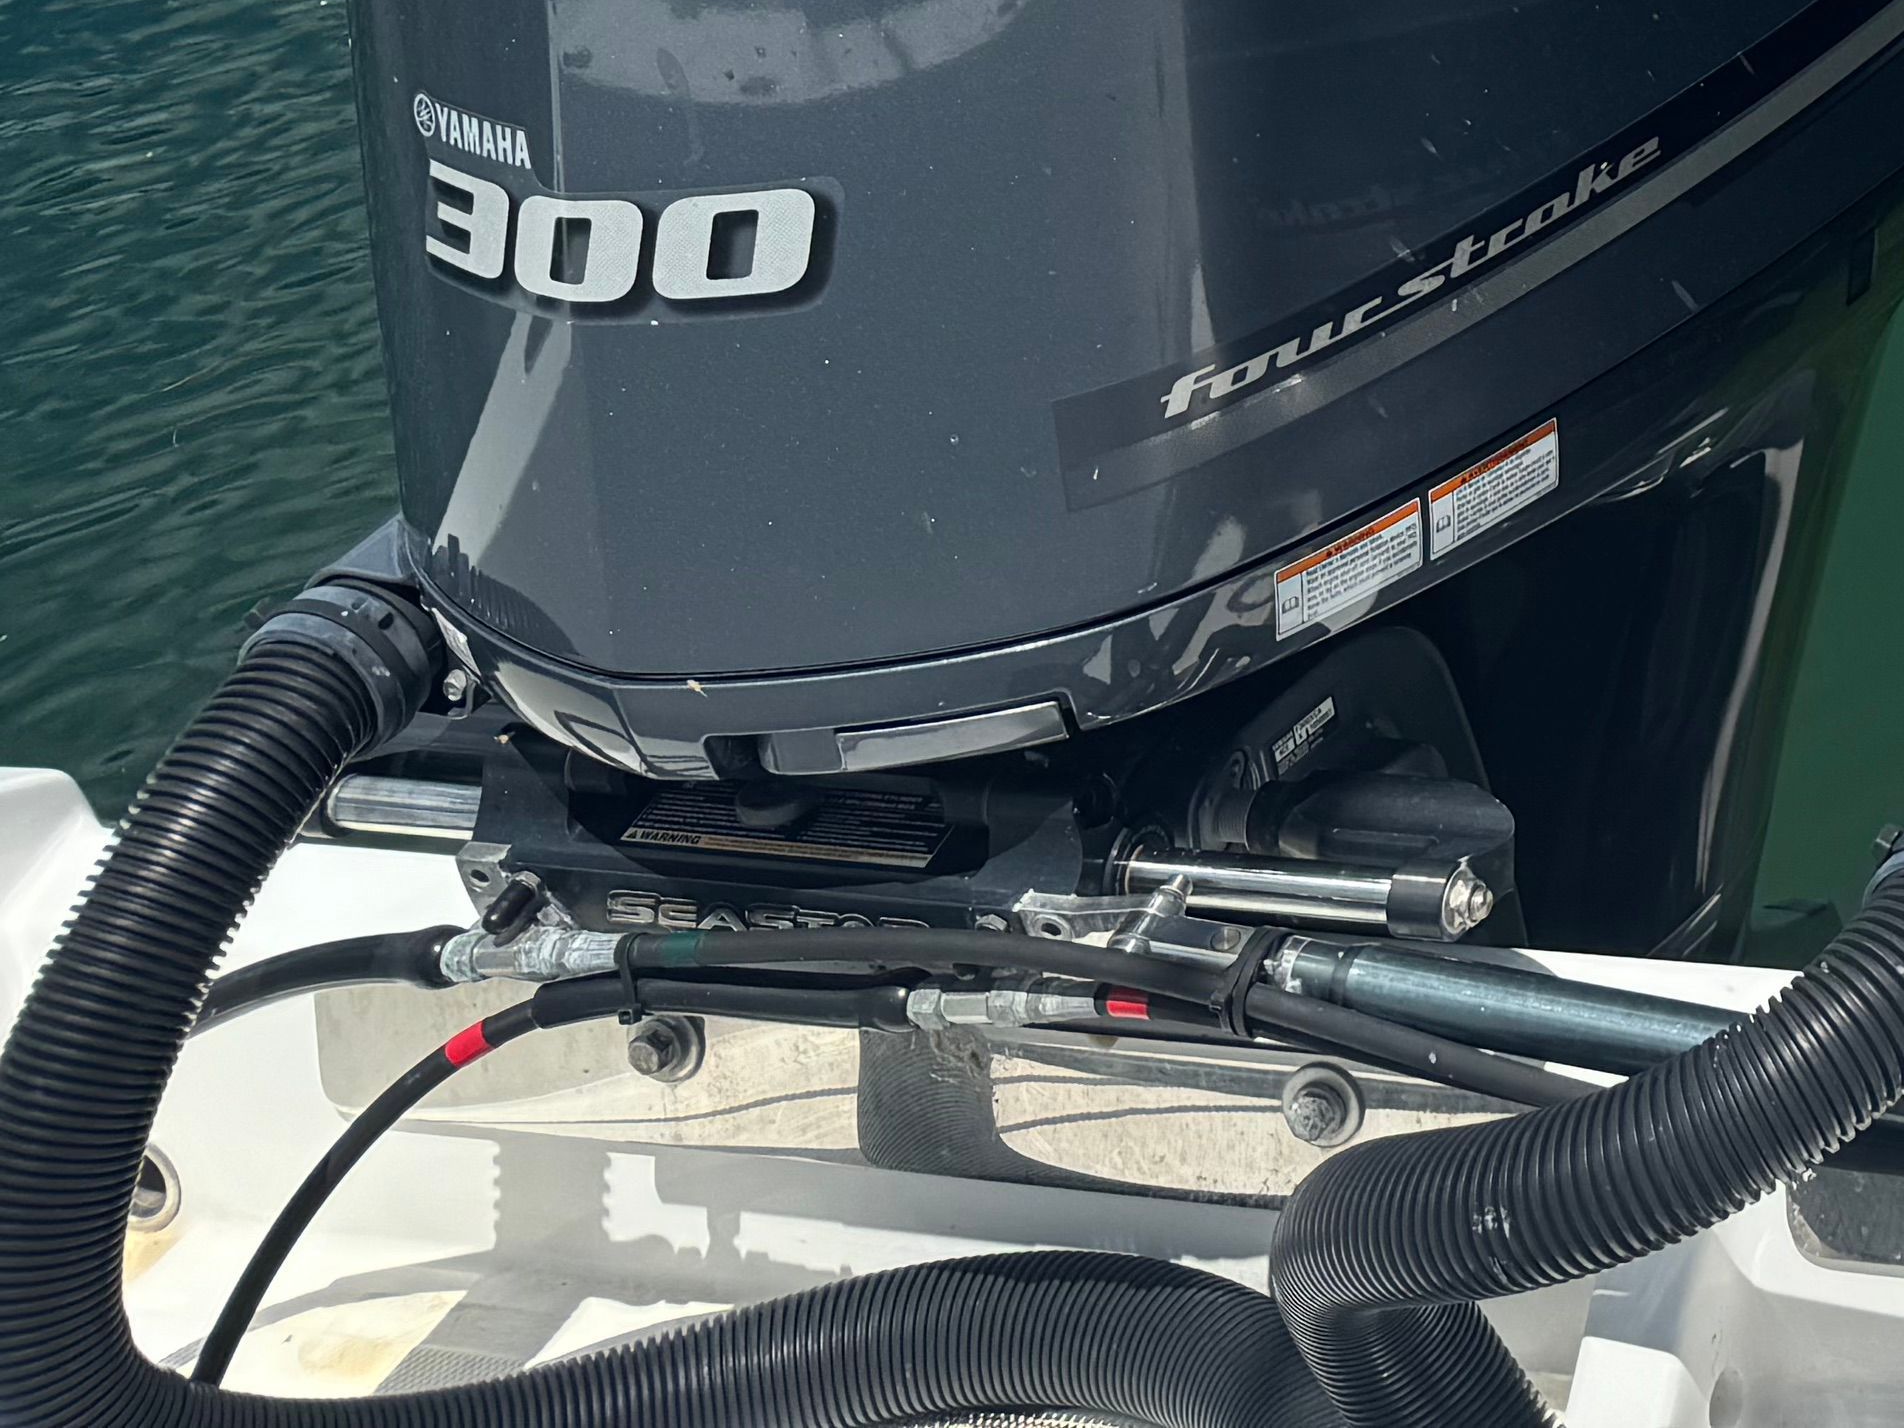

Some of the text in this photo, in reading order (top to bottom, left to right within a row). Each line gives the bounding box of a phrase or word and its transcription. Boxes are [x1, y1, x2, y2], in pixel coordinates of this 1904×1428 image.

[434, 102, 532, 169] YAMAHA
[426, 158, 815, 303] 300
[639, 830, 702, 845] WARNING
